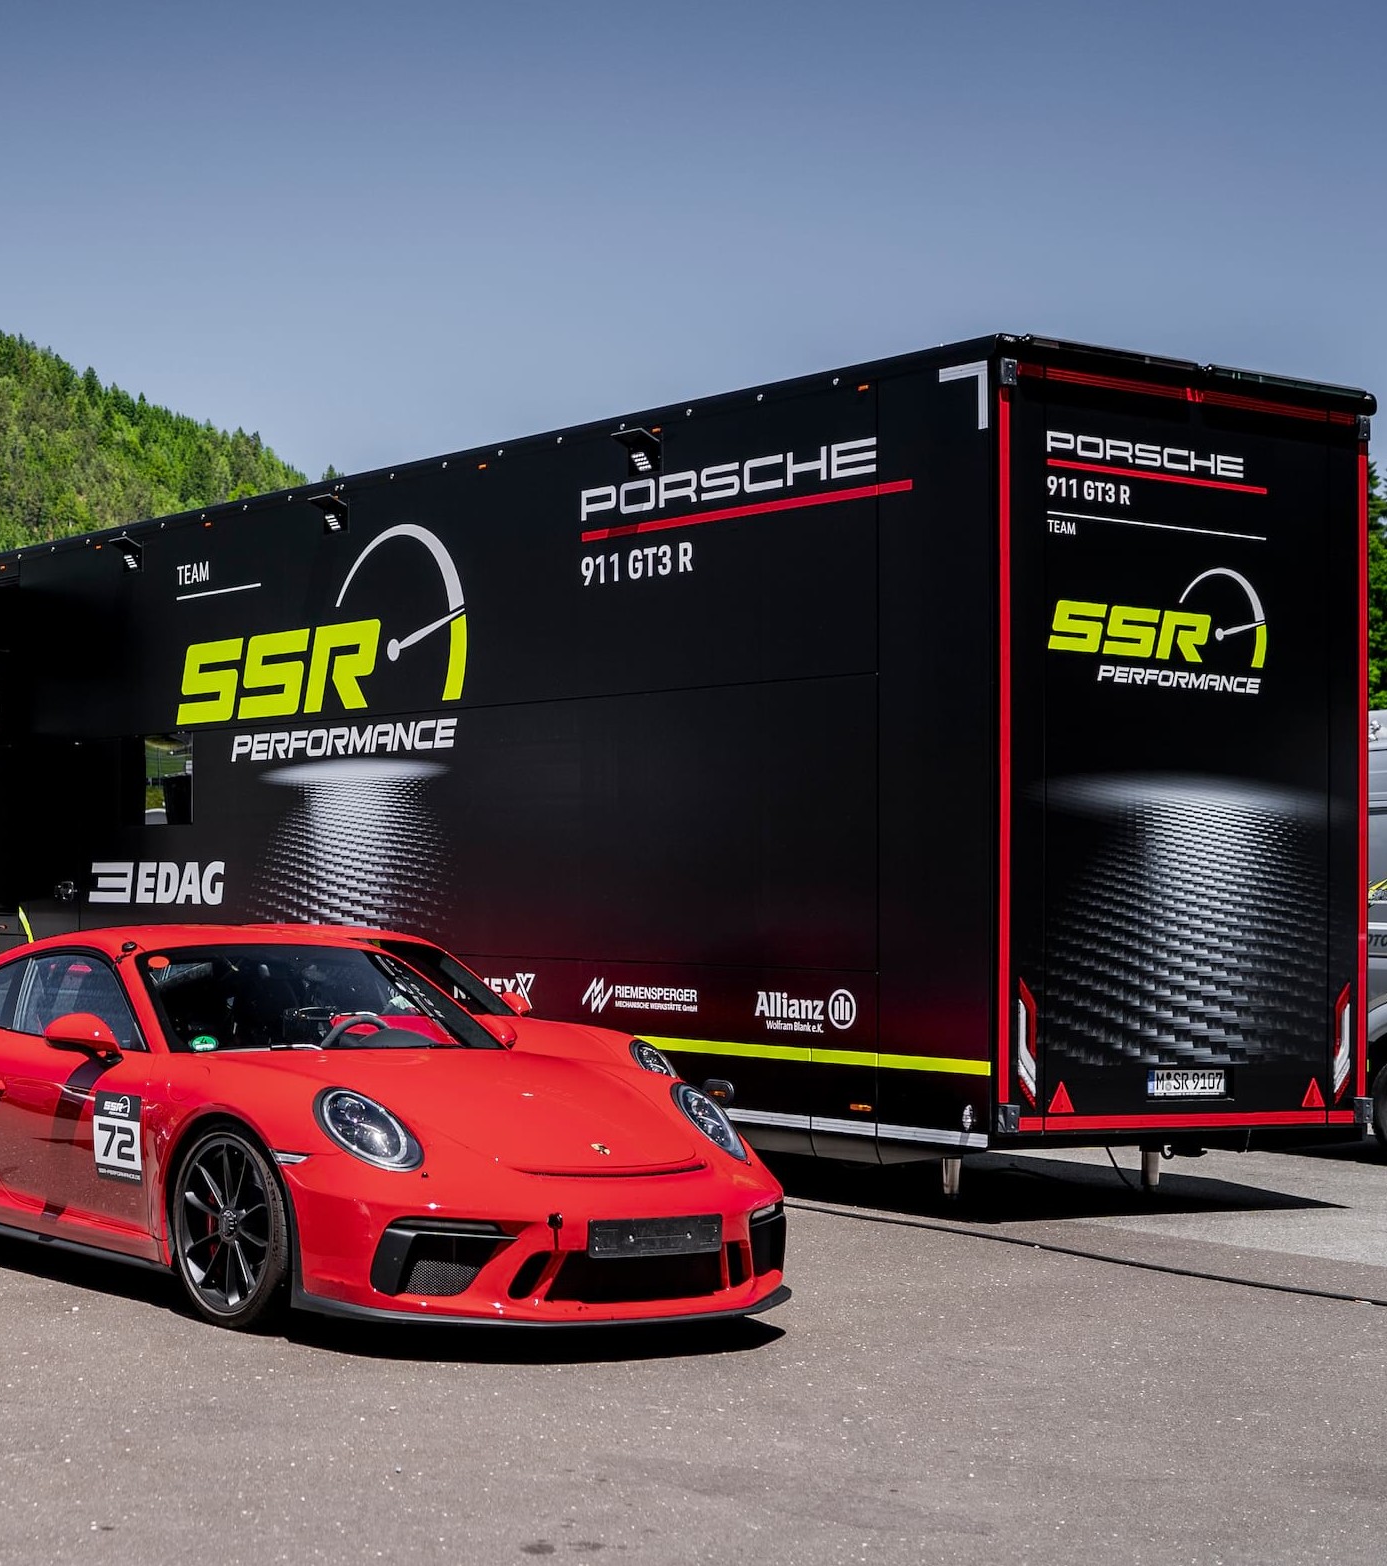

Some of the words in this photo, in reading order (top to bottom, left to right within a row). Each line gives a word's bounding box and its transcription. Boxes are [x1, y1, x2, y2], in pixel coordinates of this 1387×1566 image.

[1046, 430, 1244, 479] PORSCHE
[580, 436, 877, 522] PORSCHE
[1046, 475, 1078, 499] 911
[1083, 480, 1116, 503] GT3
[1120, 485, 1131, 505] R
[1047, 519, 1076, 535] TEAM
[176, 560, 210, 586] TEAM
[580, 552, 620, 587] 911
[627, 544, 672, 580] GT3
[678, 541, 694, 573] R
[1047, 599, 1212, 663] SSR
[176, 618, 381, 726] SSR
[1097, 664, 1262, 695] PERFORMANCE
[230, 717, 458, 763] PERFORMANCE
[135, 860, 226, 906] EDAG
[614, 985, 698, 1002] RIEMENSPERGER
[754, 990, 825, 1021] Allianz
[766, 1020, 793, 1031] Wolfram
[794, 1021, 811, 1033] Blank
[1156, 1072, 1165, 1090] M
[1173, 1072, 1189, 1090] SR
[103, 1100, 124, 1112] SSR
[98, 1123, 135, 1162] 72
